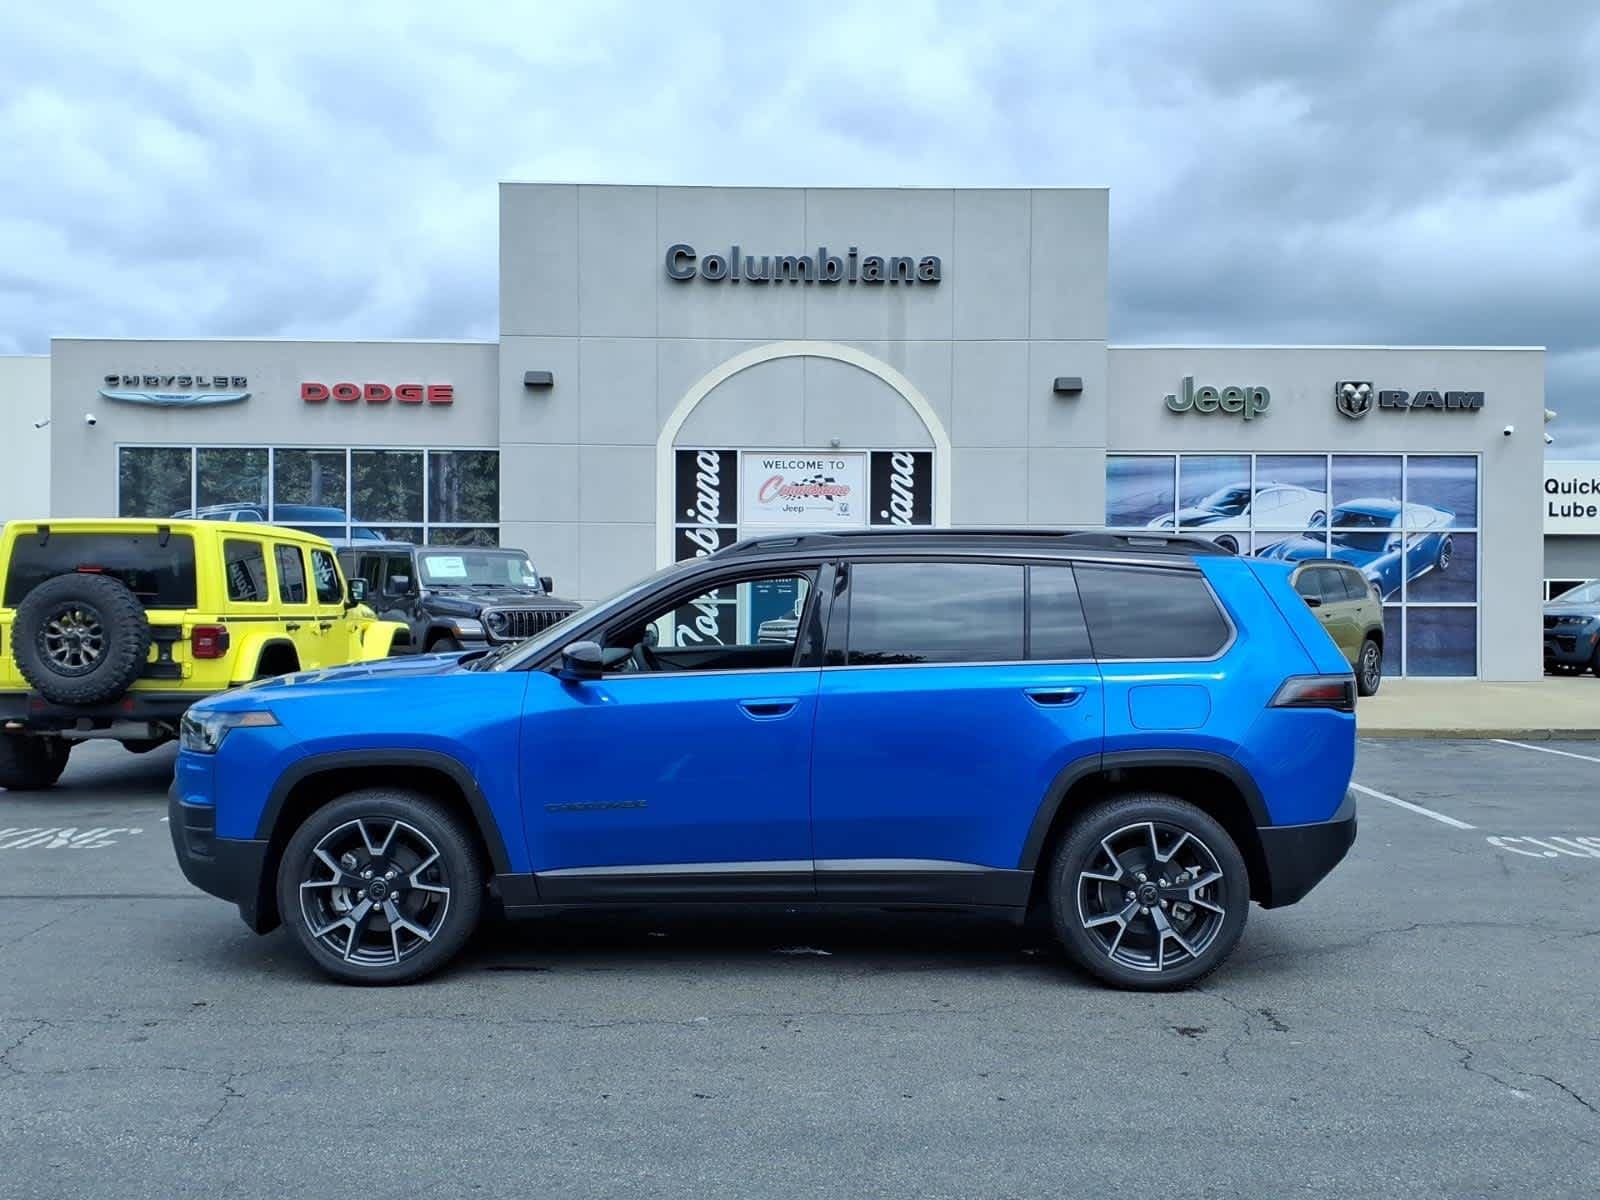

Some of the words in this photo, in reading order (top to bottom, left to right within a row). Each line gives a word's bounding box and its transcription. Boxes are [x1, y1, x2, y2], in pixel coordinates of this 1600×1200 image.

[665, 243, 942, 284] Columbiana
[104, 375, 248, 388] CHRYSLER
[301, 383, 454, 405] DODGE
[1165, 376, 1271, 420] Jeep
[1379, 390, 1485, 409] RAM
[763, 460, 824, 470] WELCOME
[829, 460, 845, 470] TO
[1544, 478, 1600, 495] Quick
[782, 504, 805, 514] Jeep
[1548, 501, 1598, 518] Lube
